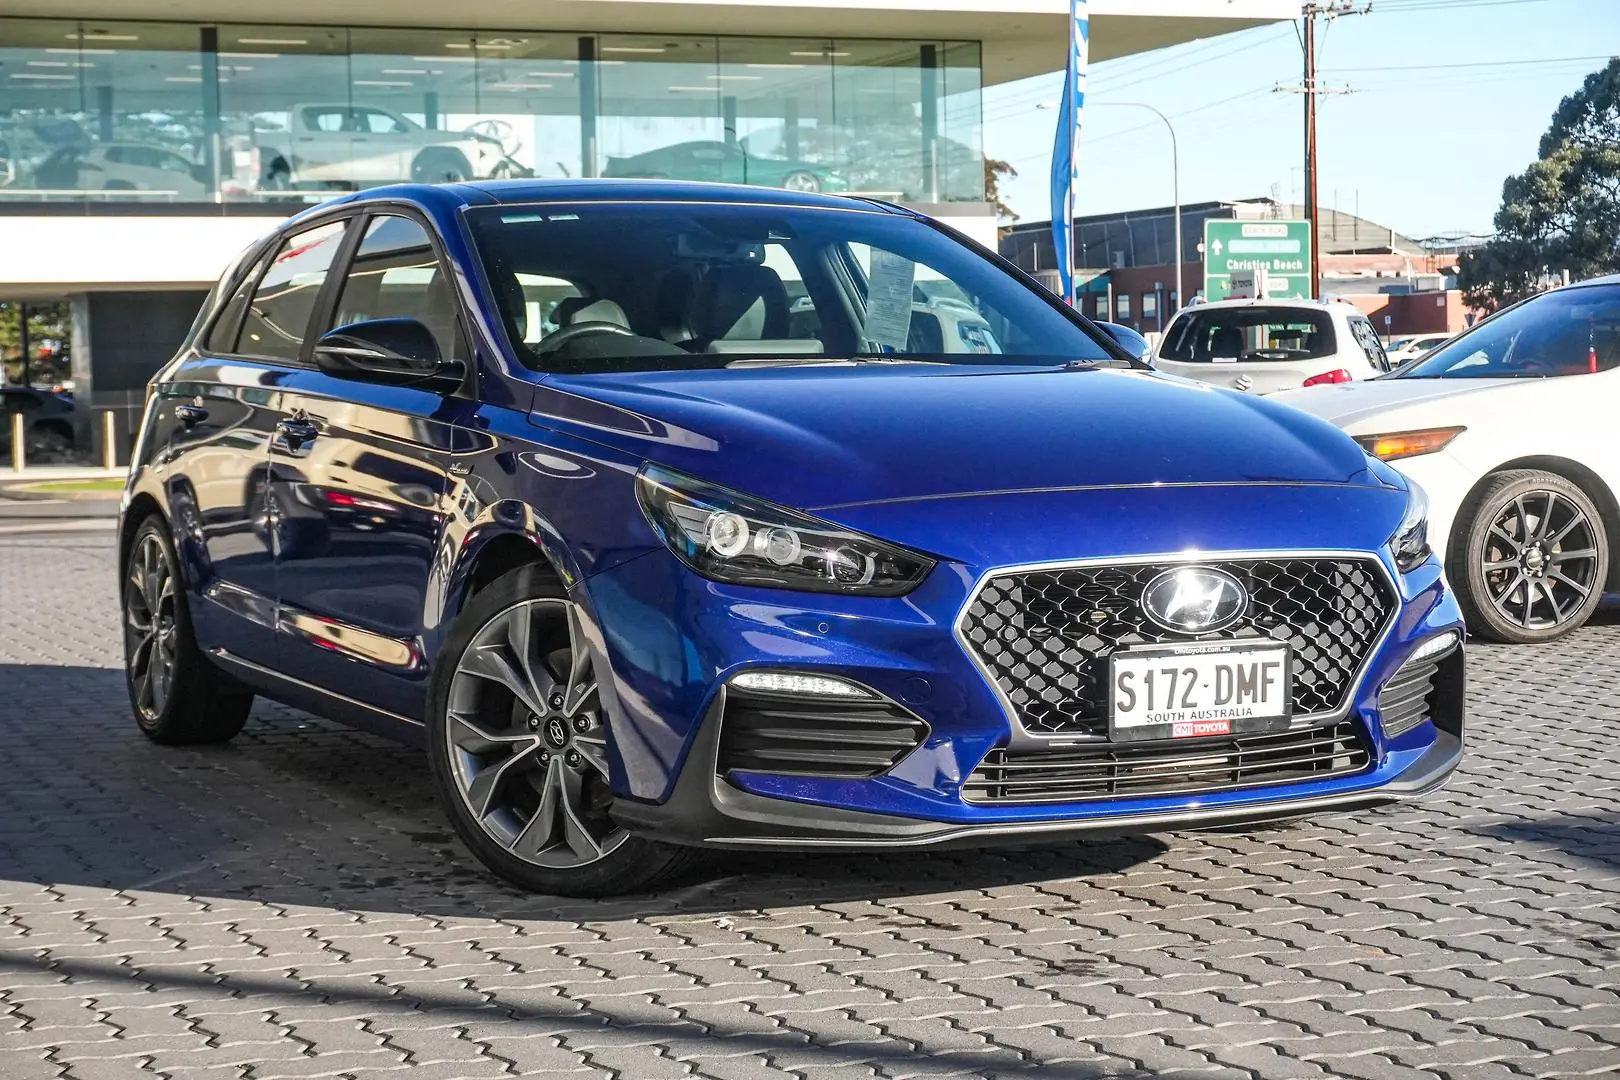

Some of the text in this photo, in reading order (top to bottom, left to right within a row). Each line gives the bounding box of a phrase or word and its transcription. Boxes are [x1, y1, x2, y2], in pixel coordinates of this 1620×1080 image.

[1226, 259, 1303, 270] Christies Beach
[1146, 707, 1253, 723] SOUTH AUSTRALIA
[1174, 721, 1230, 735] CMI TOYOTA
